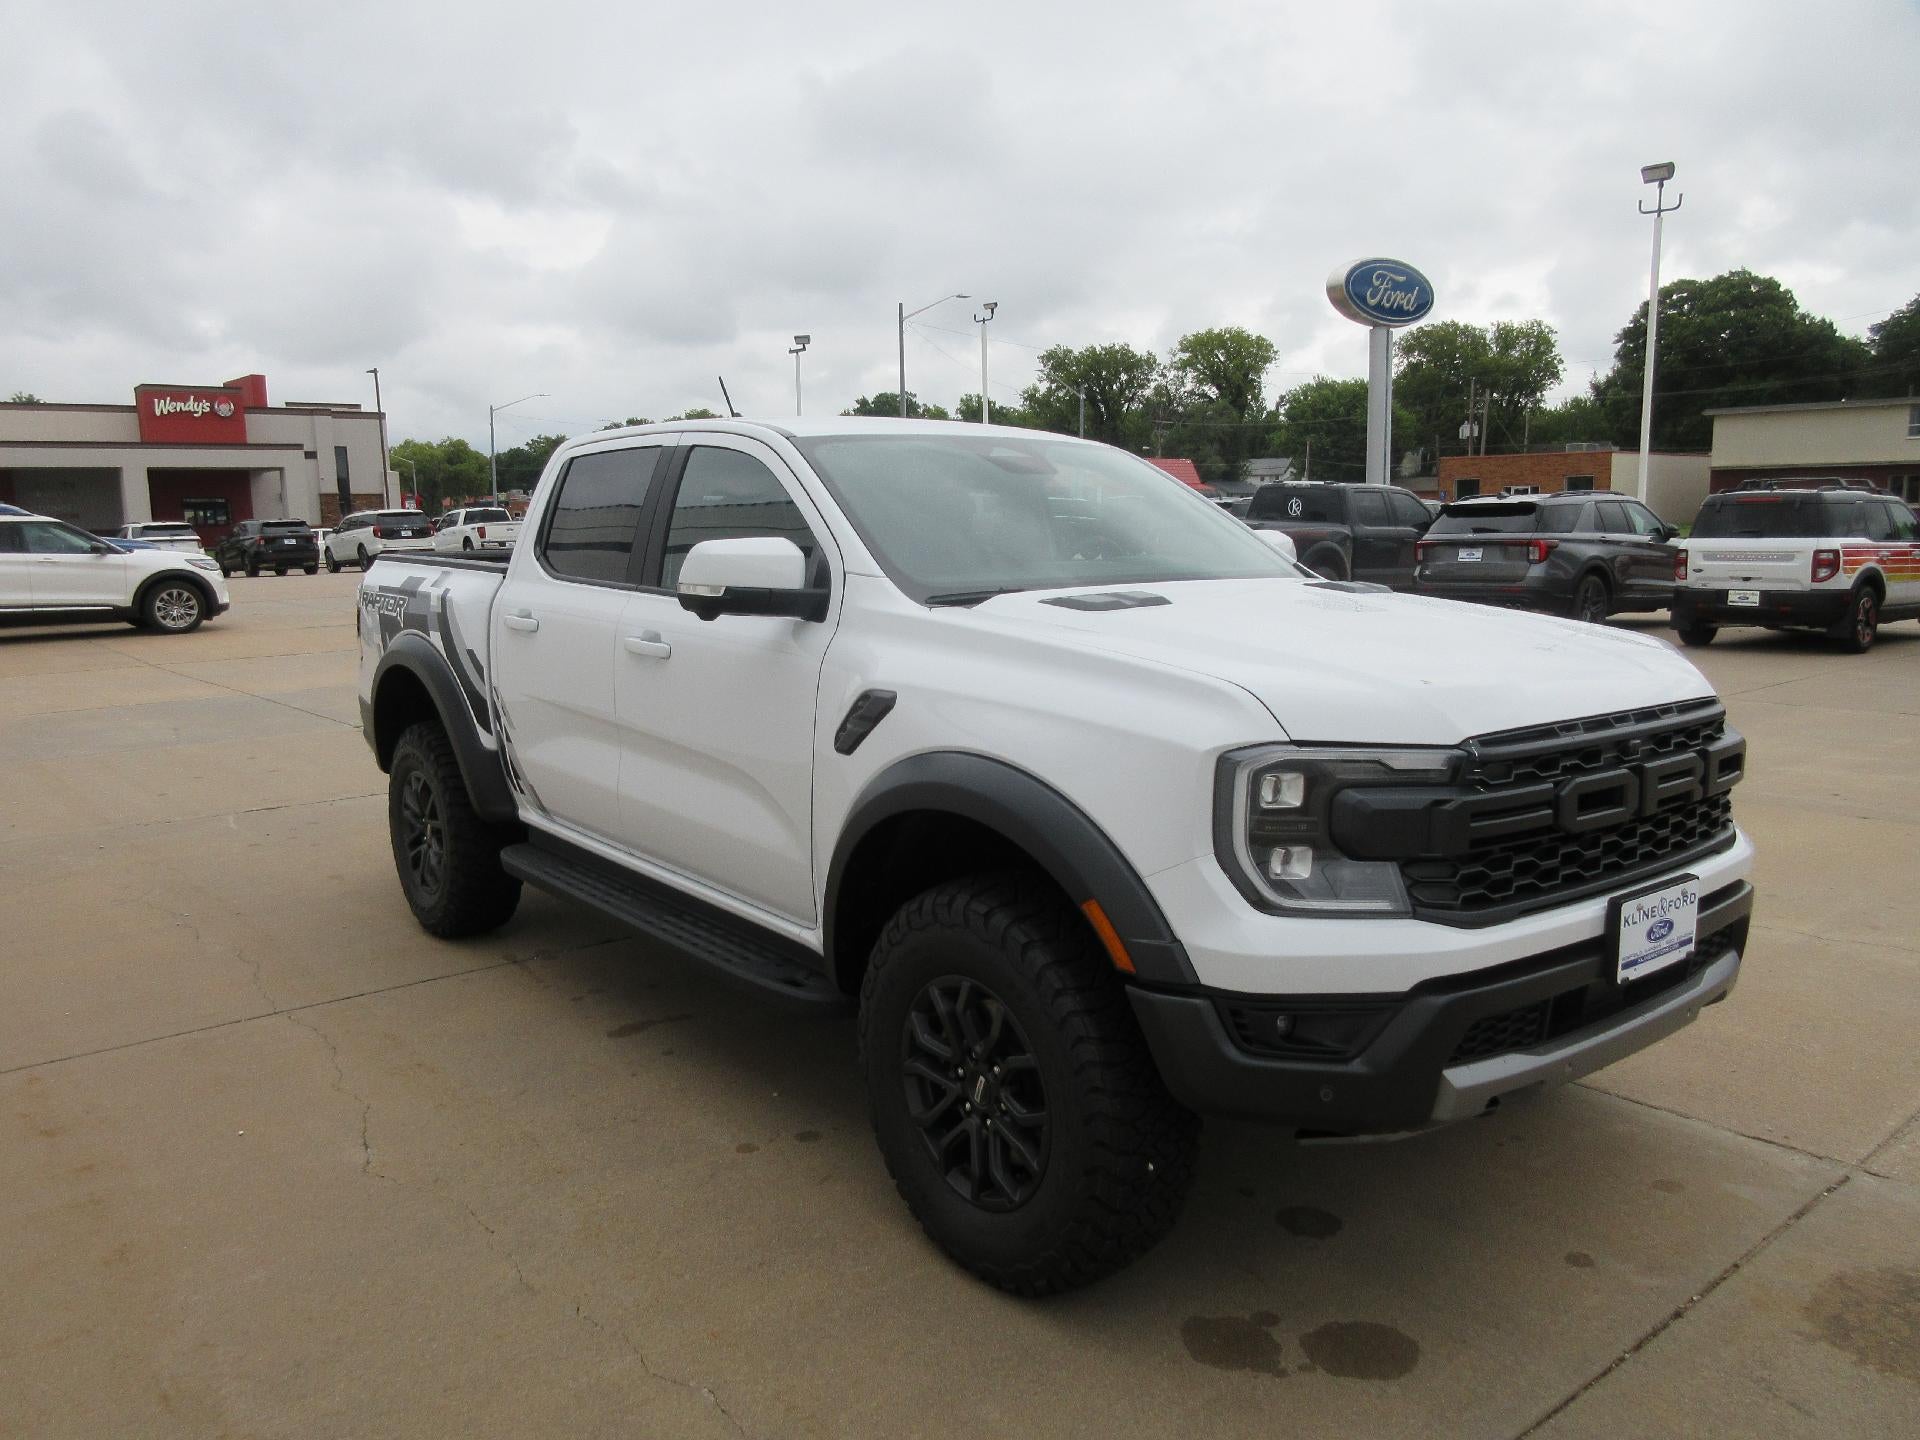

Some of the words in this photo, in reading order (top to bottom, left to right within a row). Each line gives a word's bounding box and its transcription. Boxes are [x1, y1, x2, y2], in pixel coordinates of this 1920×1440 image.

[1367, 270, 1419, 312] Ford
[153, 395, 211, 417] Wendy's
[361, 590, 409, 628] RAPTOR
[1430, 736, 1747, 857] FORD
[1623, 905, 1657, 928] KLINE
[1667, 893, 1696, 911] FORD
